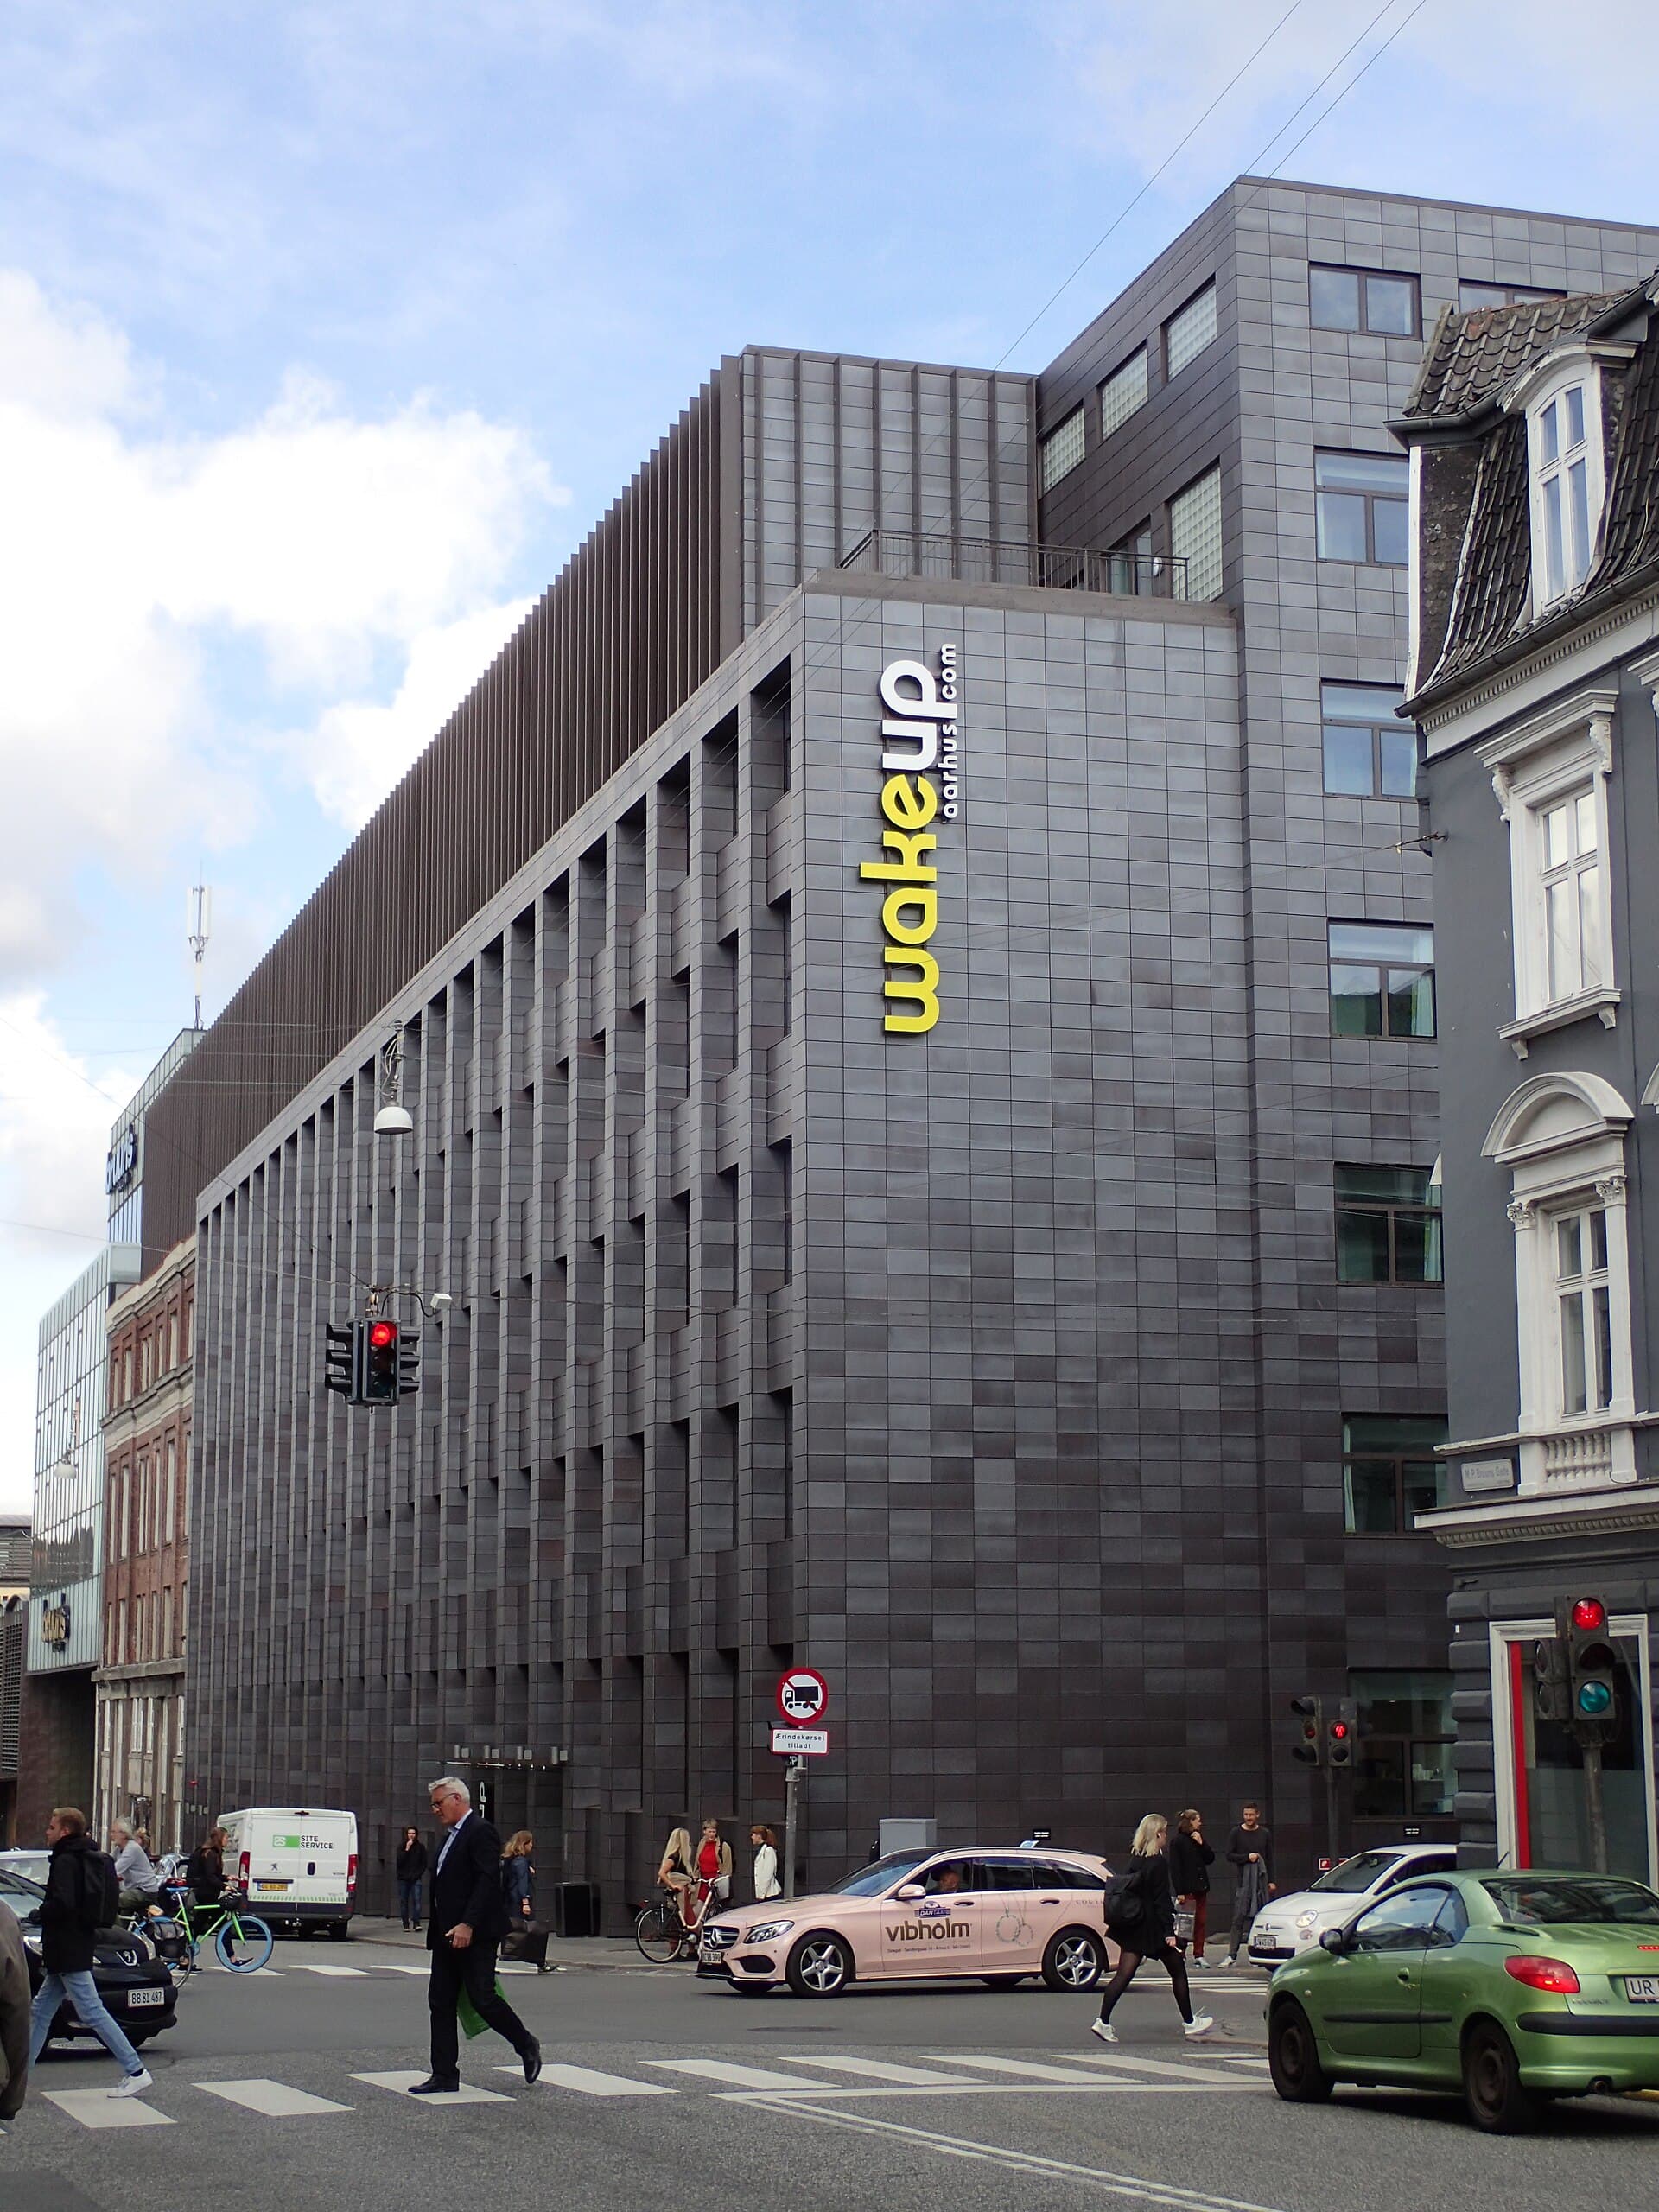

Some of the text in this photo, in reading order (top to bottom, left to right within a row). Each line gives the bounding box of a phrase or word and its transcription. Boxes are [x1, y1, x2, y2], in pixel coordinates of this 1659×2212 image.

[860, 659, 957, 1033] wakeup
[885, 1918, 970, 1942] vibholm
[1630, 1980, 1655, 1995] UR
